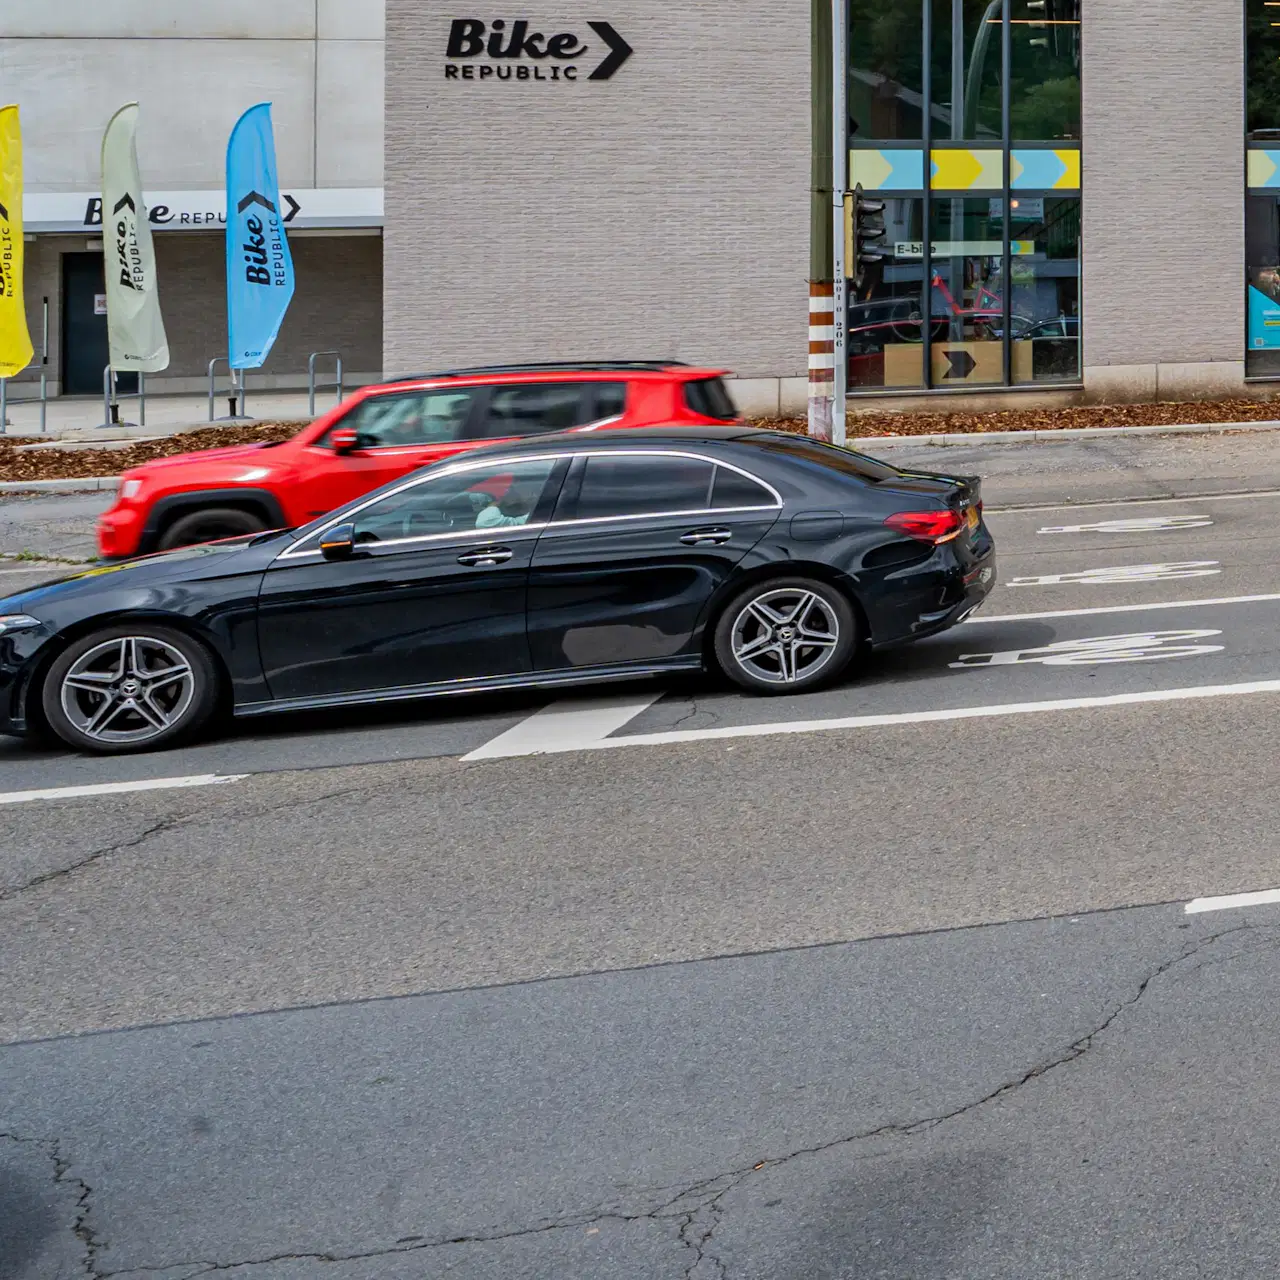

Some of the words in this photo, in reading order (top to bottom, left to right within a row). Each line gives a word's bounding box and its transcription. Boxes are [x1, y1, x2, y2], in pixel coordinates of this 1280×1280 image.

[446, 19, 588, 59] Bike
[445, 64, 577, 80] REPUBLIC
[243, 214, 270, 286] Bike
[269, 220, 286, 286] REPUBLIC
[897, 244, 937, 255] E-bie
[835, 321, 844, 348] 206
